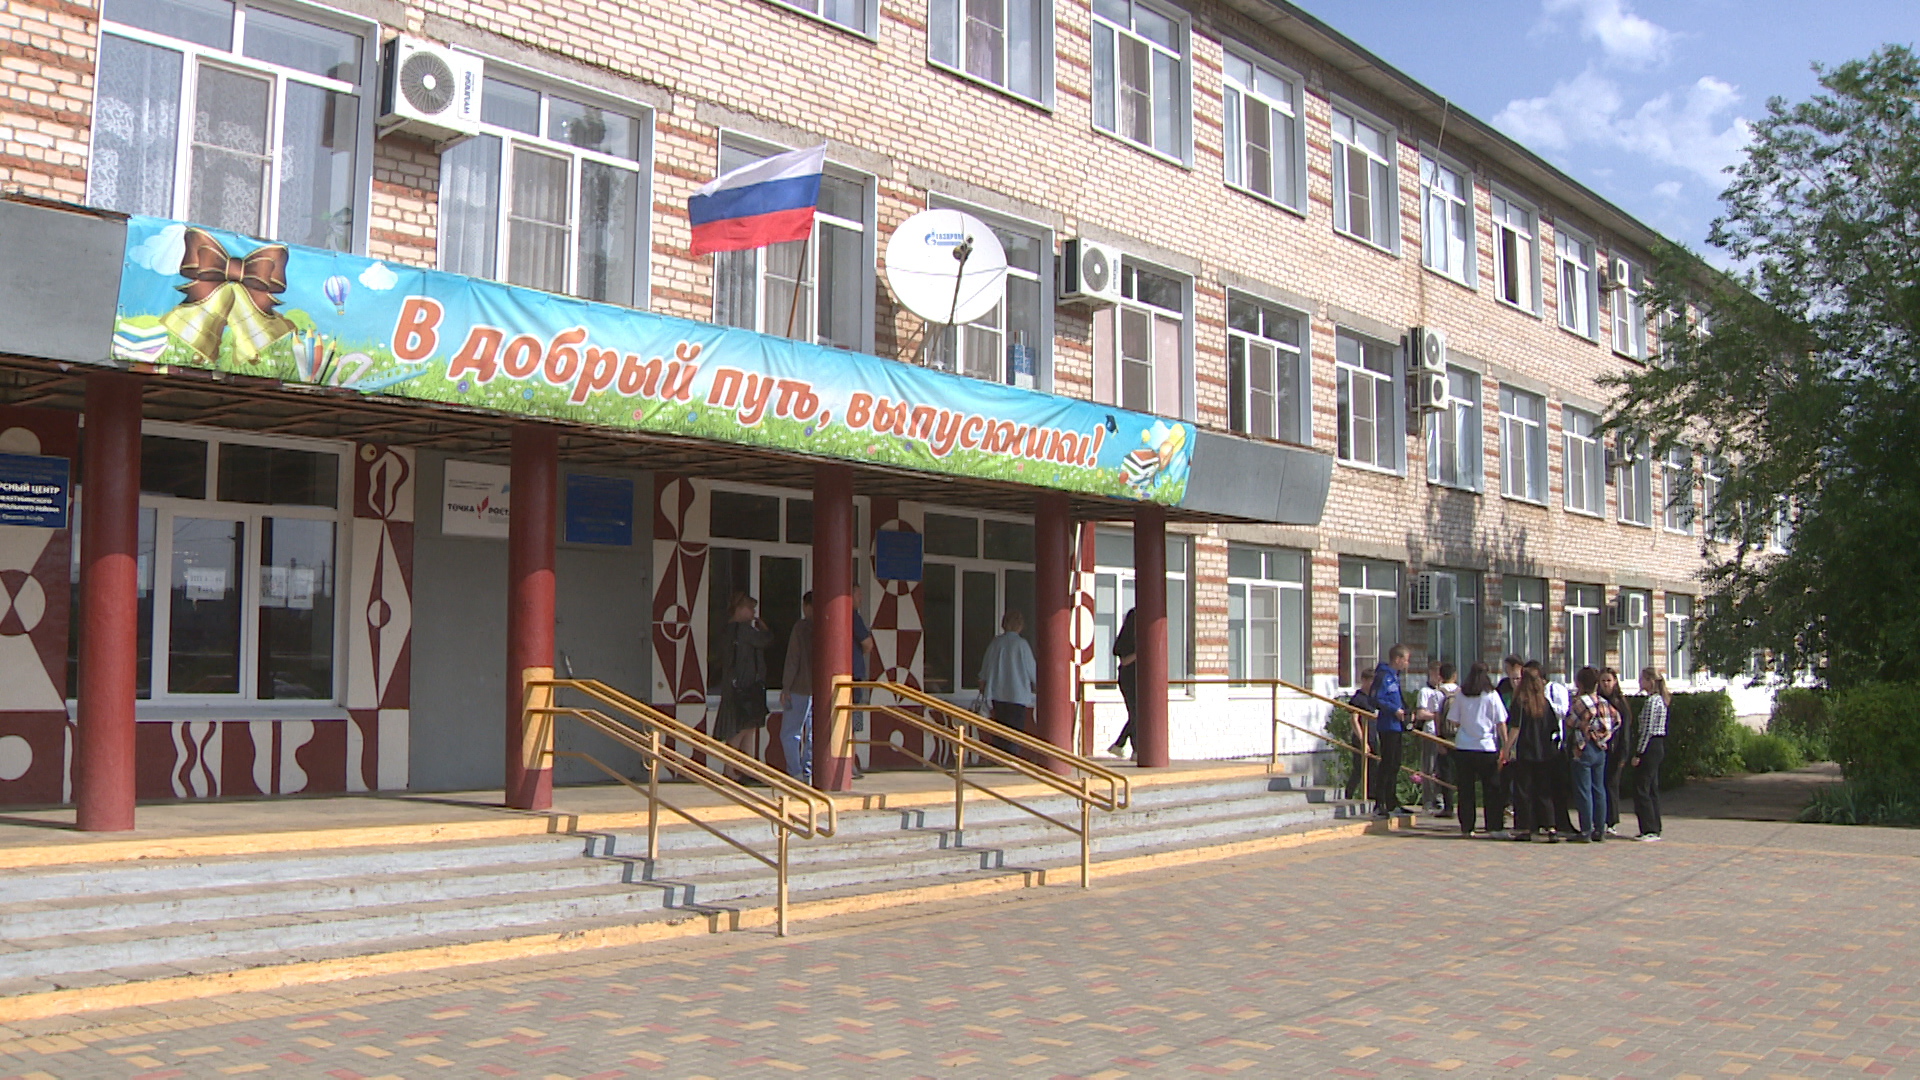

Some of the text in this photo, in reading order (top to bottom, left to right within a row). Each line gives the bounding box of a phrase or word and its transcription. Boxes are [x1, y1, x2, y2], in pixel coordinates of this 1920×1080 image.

[394, 298, 1105, 468] В добрый путь, выпускники!
[31, 485, 60, 494] ЦЕНТР
[448, 503, 510, 516] ТОЧКА РОСТ
